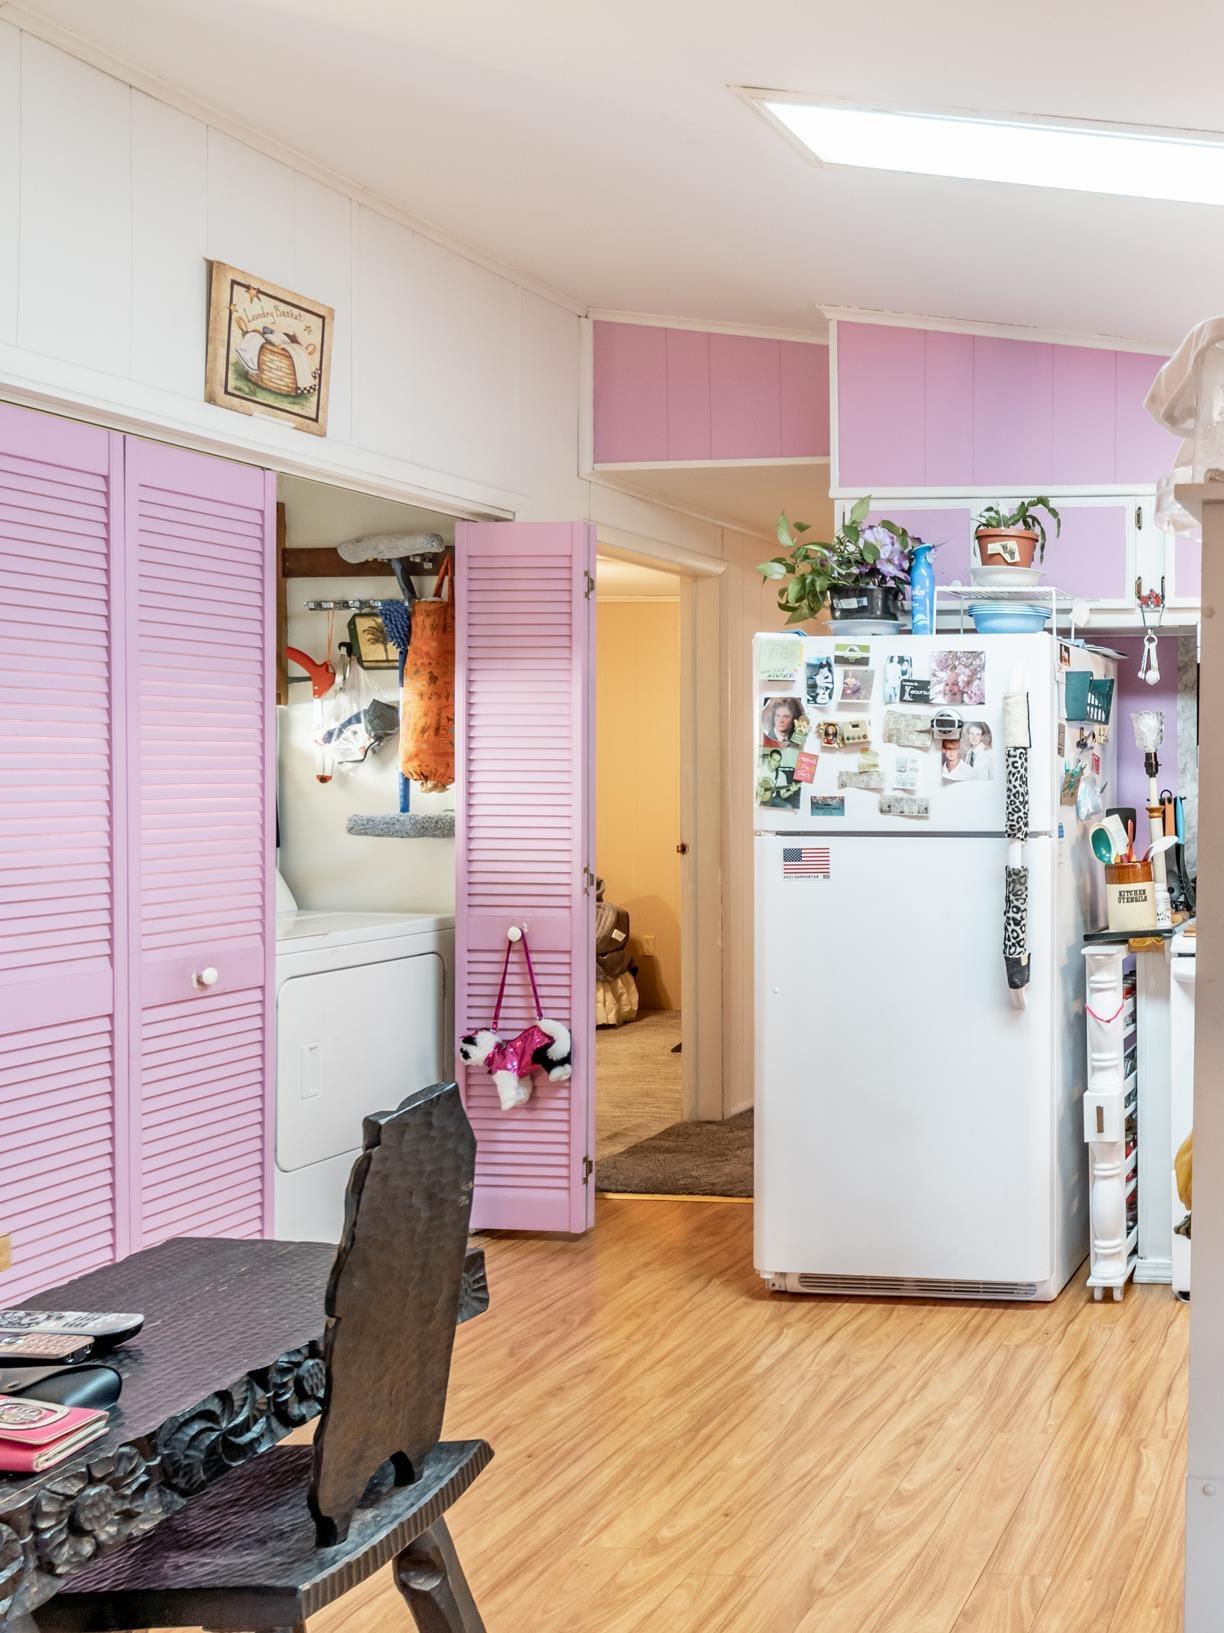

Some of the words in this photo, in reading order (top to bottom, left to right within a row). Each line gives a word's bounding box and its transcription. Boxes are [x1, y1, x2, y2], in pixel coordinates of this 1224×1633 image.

[243, 305, 276, 325] Laundry
[274, 304, 302, 322] Basket
[1118, 889, 1146, 897] KITCHEN
[1118, 896, 1147, 904] UTENSILS
